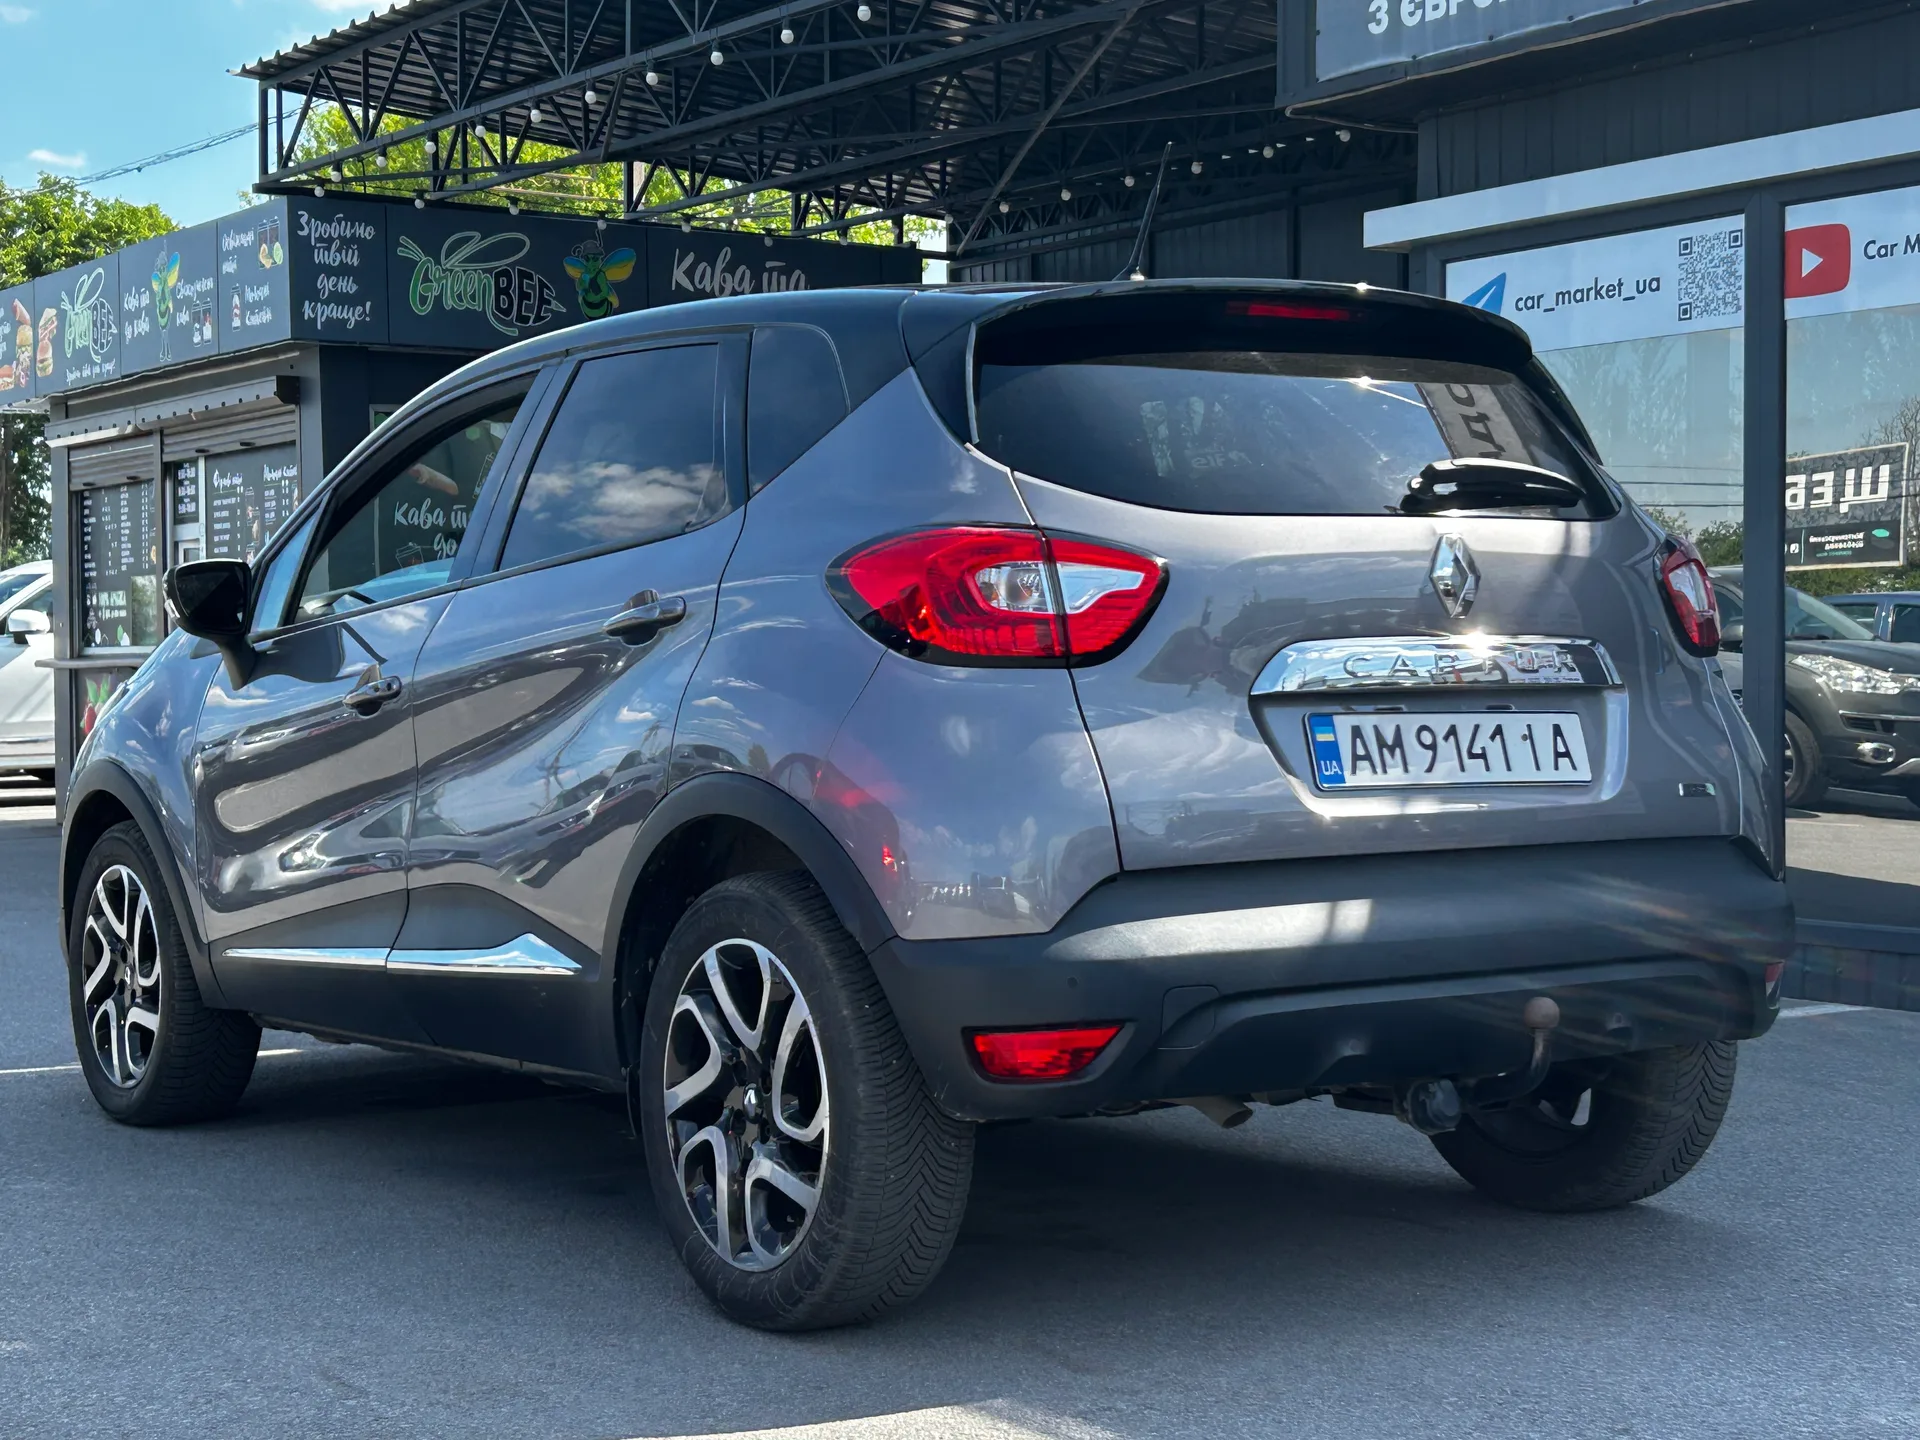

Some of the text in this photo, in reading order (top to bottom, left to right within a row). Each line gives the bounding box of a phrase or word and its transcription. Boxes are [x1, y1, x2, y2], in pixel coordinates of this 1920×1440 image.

[1400, 0, 1494, 27] ЄВ
[297, 210, 376, 246] Зробимо
[314, 239, 360, 267] твій
[1864, 240, 1899, 260] Car
[317, 273, 359, 299] день
[671, 246, 811, 298] Кава та
[1514, 276, 1661, 313] car_market_ua
[302, 300, 372, 330] краще!
[394, 497, 468, 530] Кава т
[1320, 760, 1343, 777] UA
